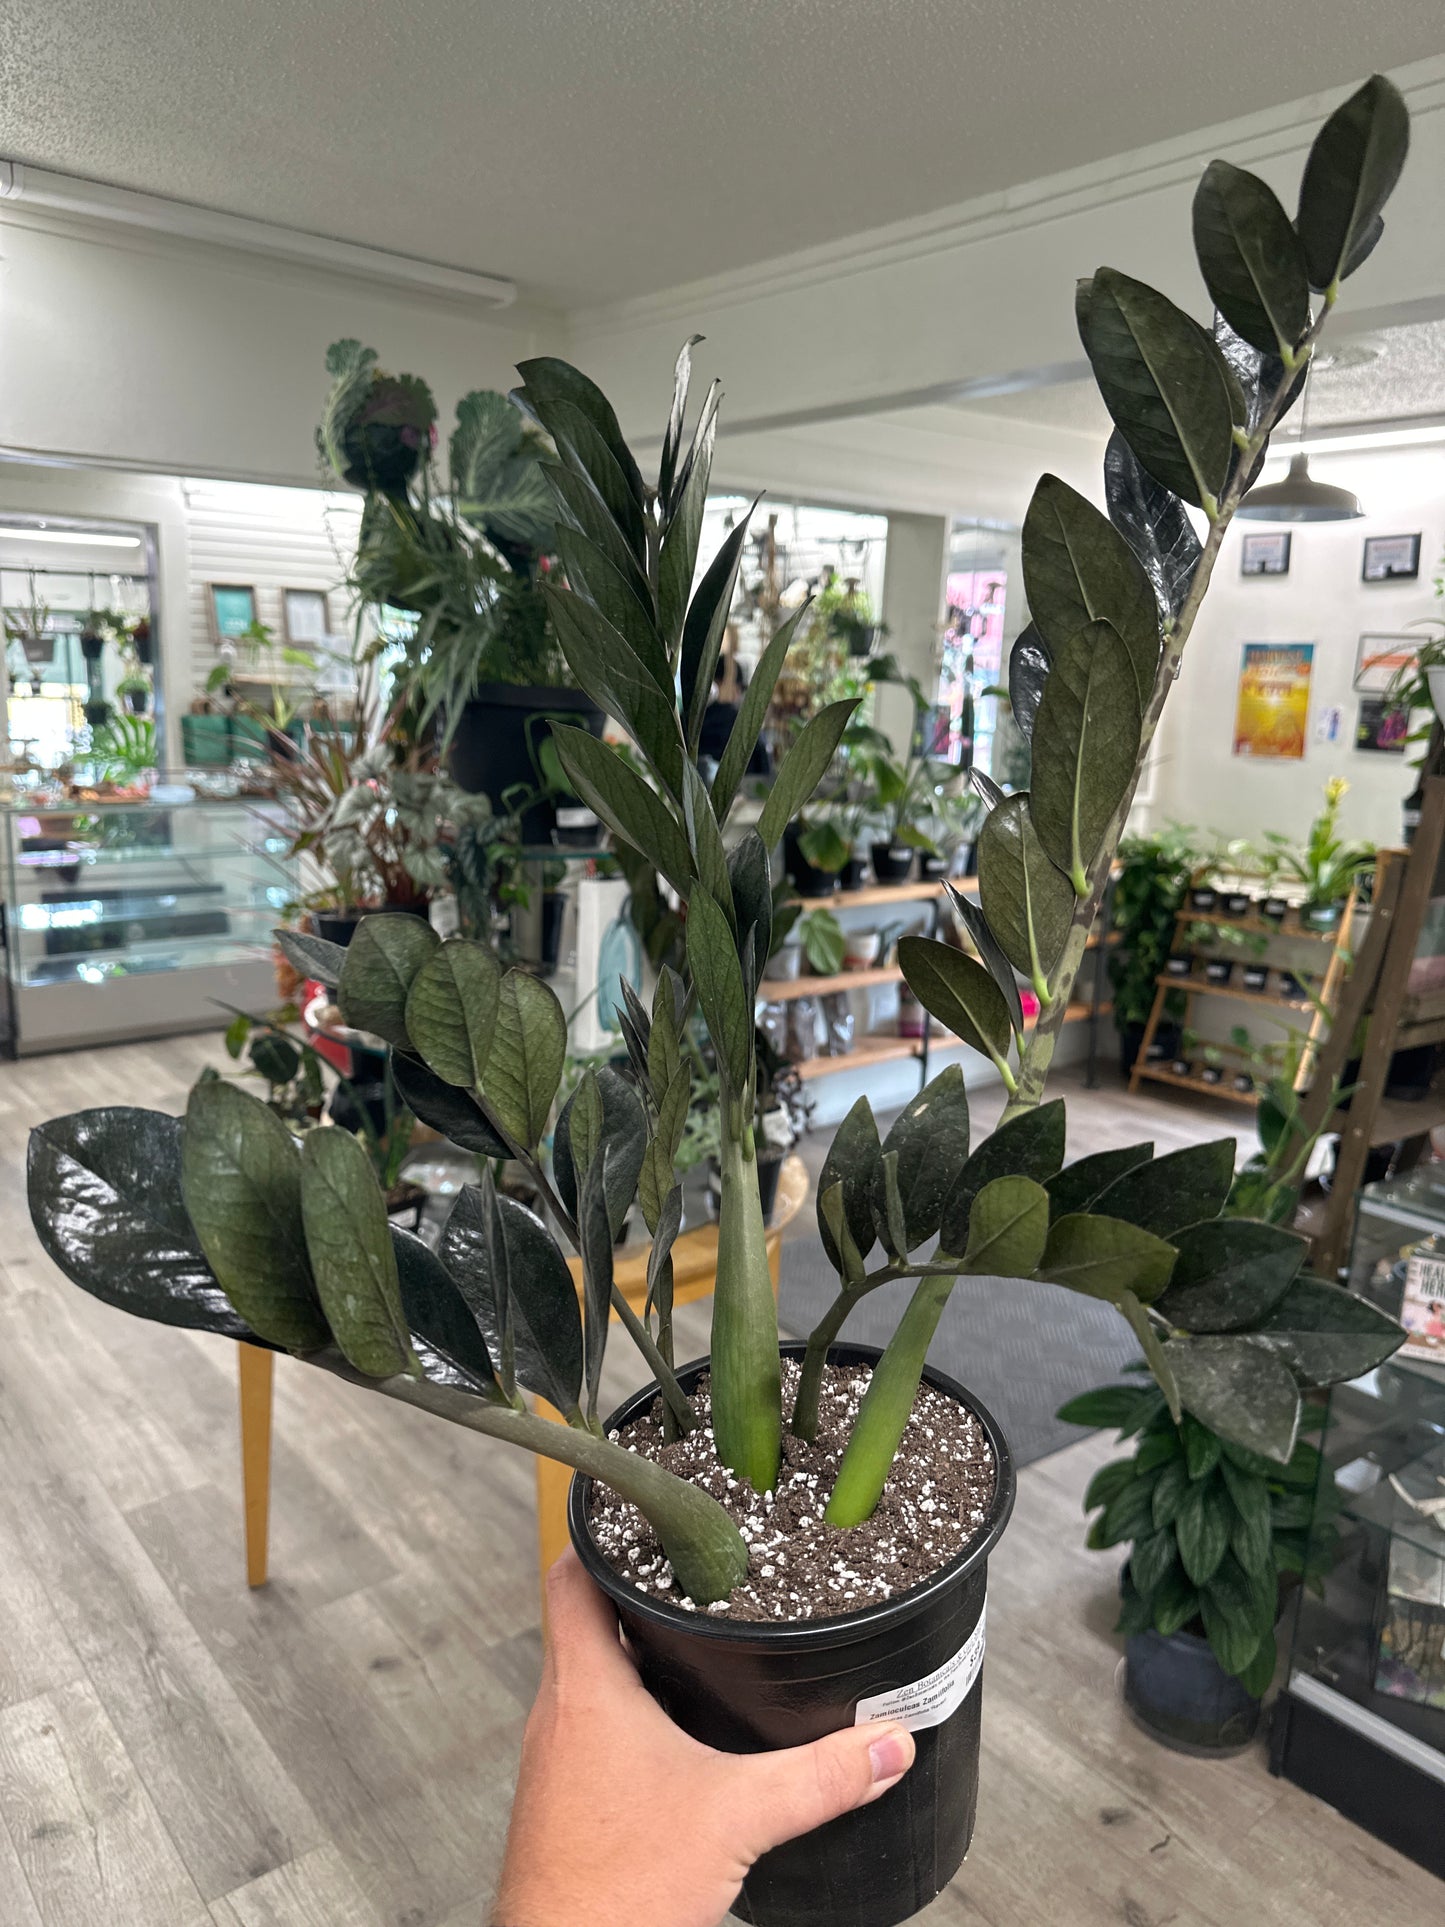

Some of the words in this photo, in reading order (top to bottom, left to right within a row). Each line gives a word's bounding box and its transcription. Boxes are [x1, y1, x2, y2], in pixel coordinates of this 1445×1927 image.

[896, 1687, 914, 1698] Zen
[917, 1661, 955, 1690] Botanicals
[869, 1702, 920, 1720] Zamioculcas
[922, 1680, 954, 1705] Zamiifolia
